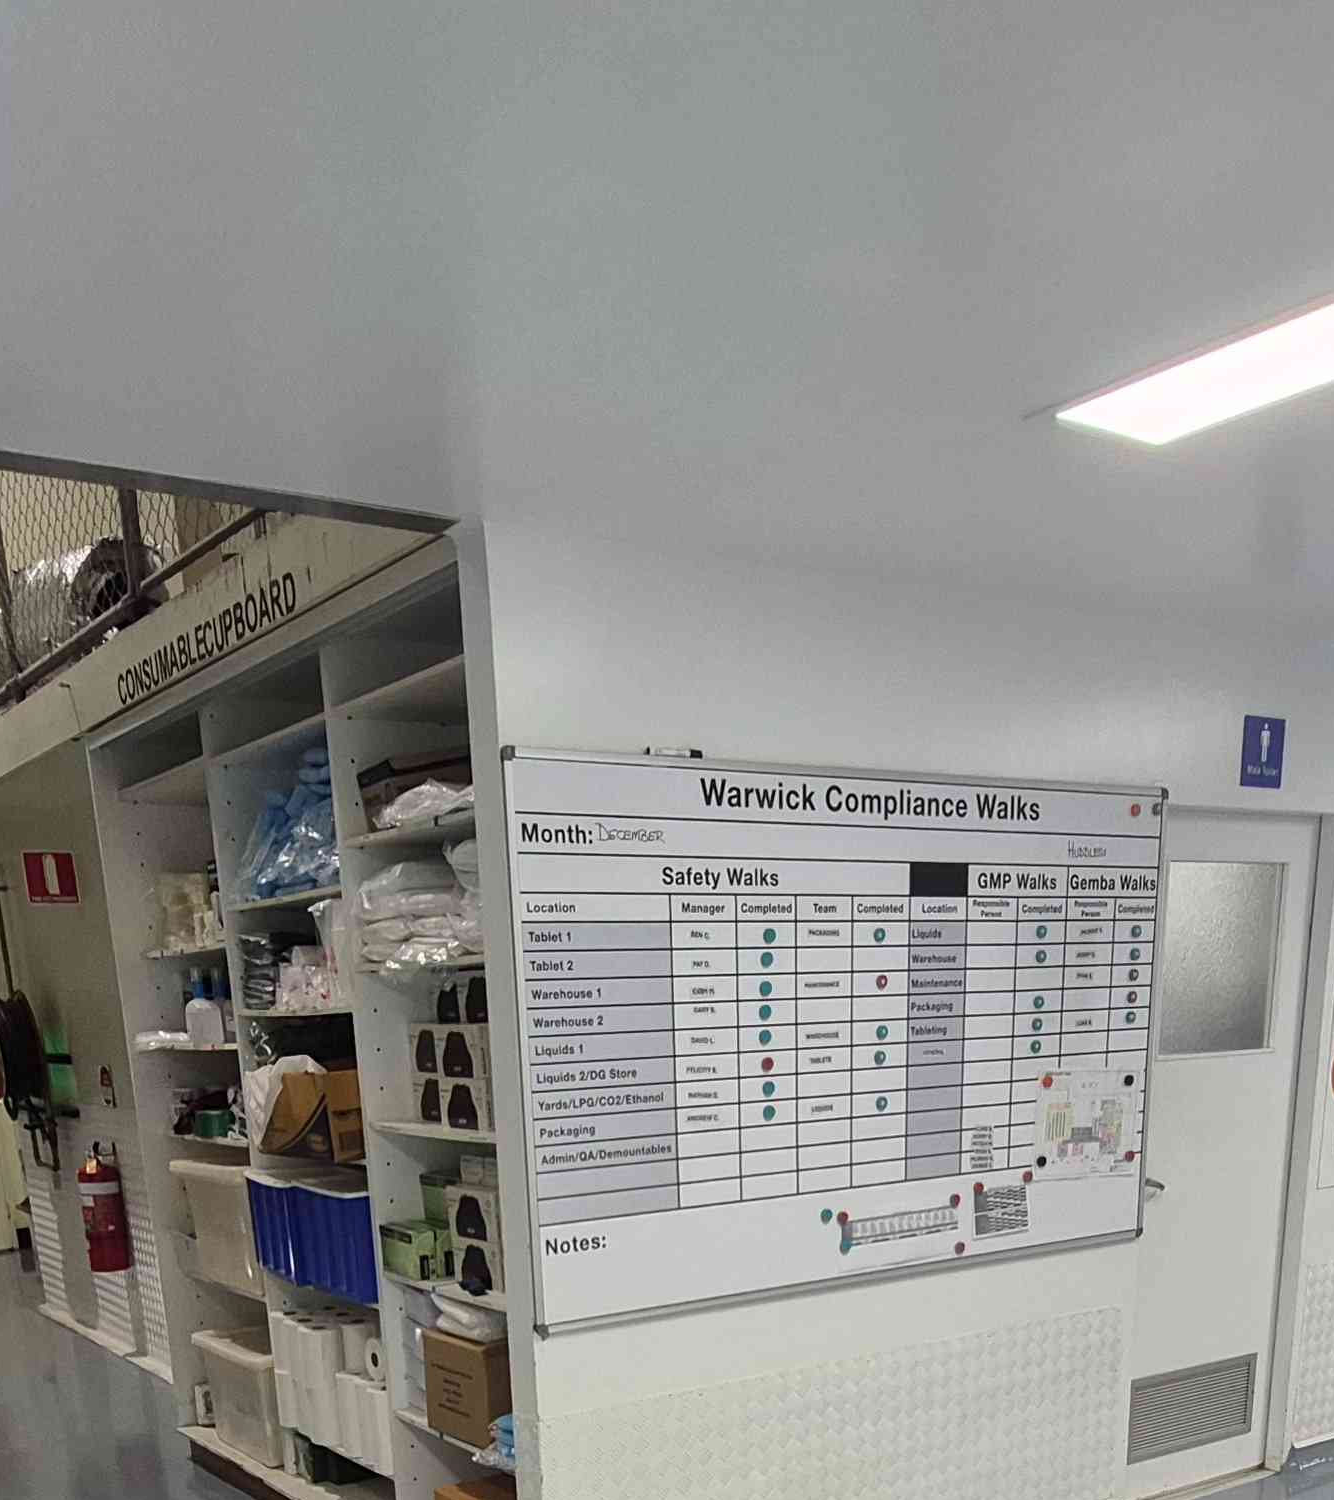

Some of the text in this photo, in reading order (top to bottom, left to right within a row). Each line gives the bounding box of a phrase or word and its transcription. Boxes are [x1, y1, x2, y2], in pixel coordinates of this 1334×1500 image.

[700, 778, 1041, 821] Warwick Compliance Walks
[521, 822, 594, 844] Month:
[662, 866, 779, 890] Safety Walks
[977, 872, 1057, 890] GMP Walks
[1069, 874, 1156, 892] Gemba Walks
[526, 901, 576, 913] Location
[681, 902, 726, 916] Manager
[740, 902, 793, 916] Completed
[813, 903, 837, 914] Team
[856, 903, 904, 915] Completed
[921, 903, 958, 915] Location
[1021, 904, 1063, 915] Completed
[1117, 903, 1155, 914] Completed
[528, 931, 572, 943] Tablet 1
[911, 928, 942, 940] Liquids
[911, 954, 957, 964] Warehouse
[529, 960, 574, 972] Tablet 2
[911, 977, 963, 989] Maintenance
[531, 988, 602, 1000] Warehouse 1
[910, 1000, 954, 1013] Packaging
[532, 1016, 604, 1029] Warehouse 2
[535, 1044, 584, 1058] Liquids 1
[536, 1068, 637, 1086] Liquids 2/DG Store
[538, 1091, 664, 1112] Yards/LPG/CO2/Ethanol
[539, 1124, 596, 1139] Packaging
[541, 1143, 672, 1166] Admin/QA/Demountables
[545, 1234, 607, 1257] Notes:
